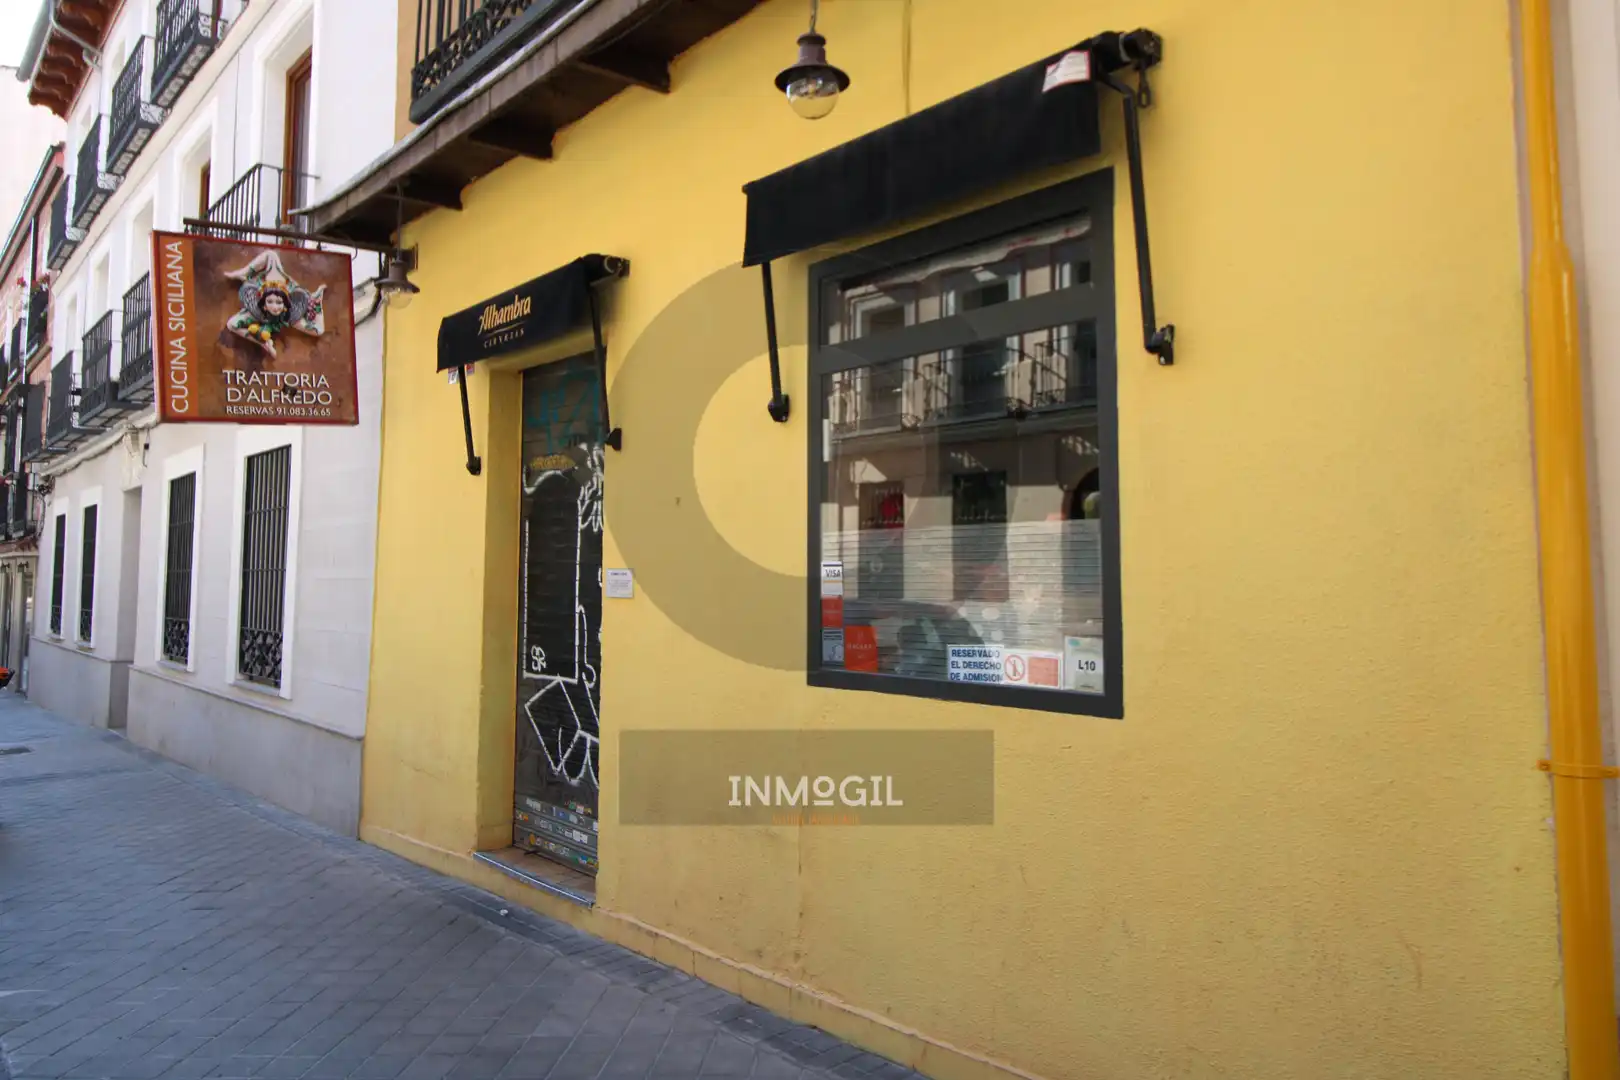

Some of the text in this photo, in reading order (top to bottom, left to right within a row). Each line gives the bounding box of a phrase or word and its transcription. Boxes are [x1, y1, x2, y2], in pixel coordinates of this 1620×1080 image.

[478, 294, 532, 336] Alhambra
[165, 240, 189, 413] CUCINA SICILIANA
[222, 369, 329, 389] TRATTORIA
[226, 387, 332, 406] D'ALFREDO
[226, 405, 331, 417] RESERVAS 91.083.36.65
[825, 569, 841, 578] VISA
[950, 660, 1002, 670] EL DERECHO
[1078, 659, 1096, 671] L10
[950, 672, 961, 681] DE
